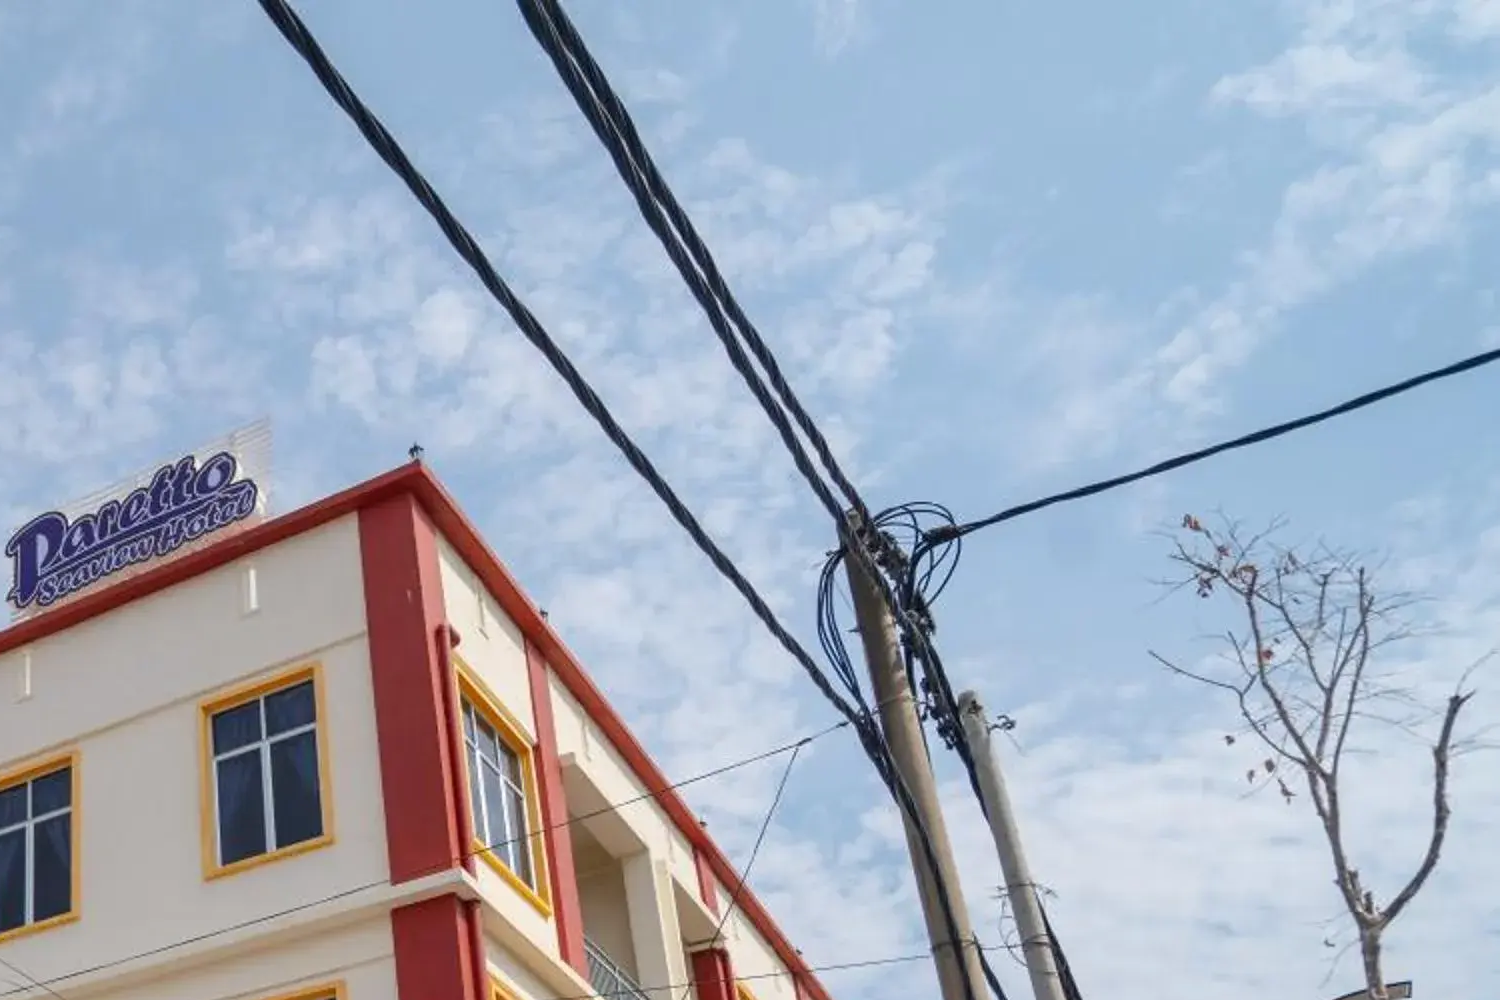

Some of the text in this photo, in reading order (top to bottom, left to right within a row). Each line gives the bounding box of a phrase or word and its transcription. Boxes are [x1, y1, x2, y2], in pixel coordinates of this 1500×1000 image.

[6, 451, 237, 608] Paretto
[36, 479, 257, 606] Seaview Hotel
